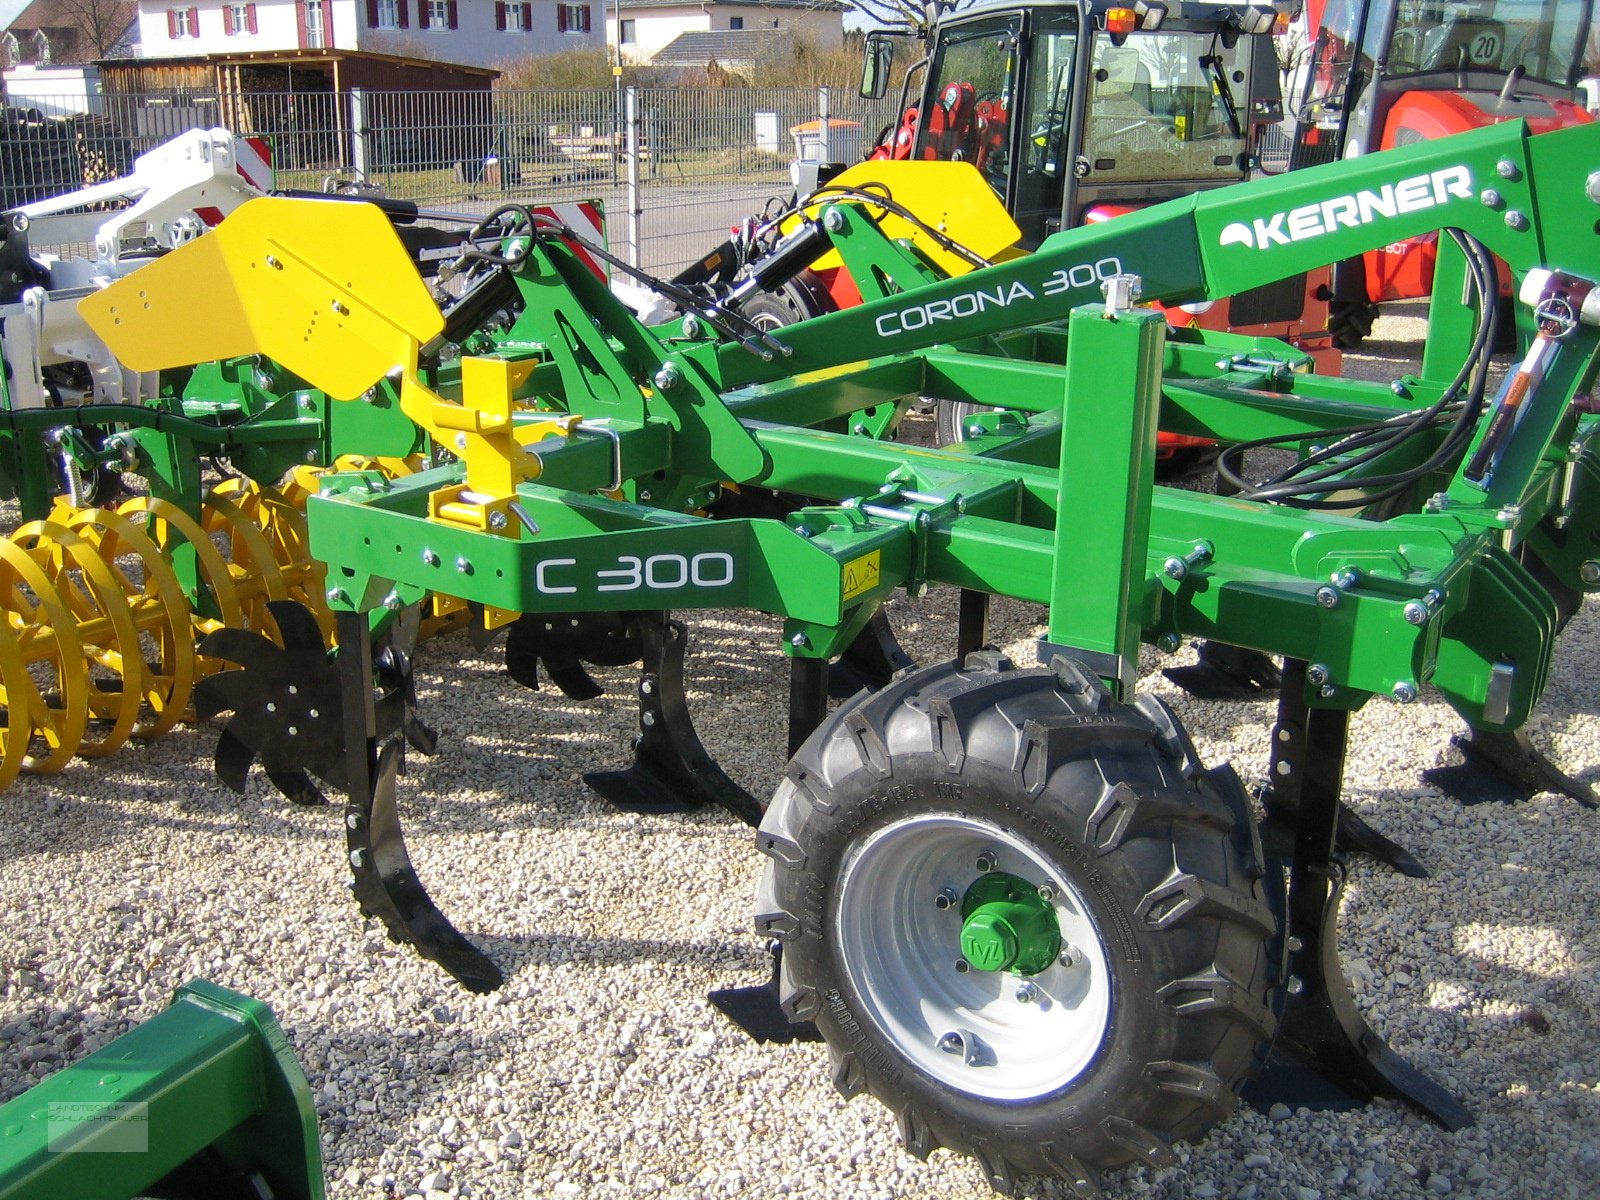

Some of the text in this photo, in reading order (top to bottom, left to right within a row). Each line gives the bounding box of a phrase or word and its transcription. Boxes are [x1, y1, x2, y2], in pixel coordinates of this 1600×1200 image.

[1474, 37, 1495, 58] 20
[1253, 165, 1472, 250] KERNER
[875, 257, 1122, 337] CORONA 300
[536, 552, 734, 594] C 300
